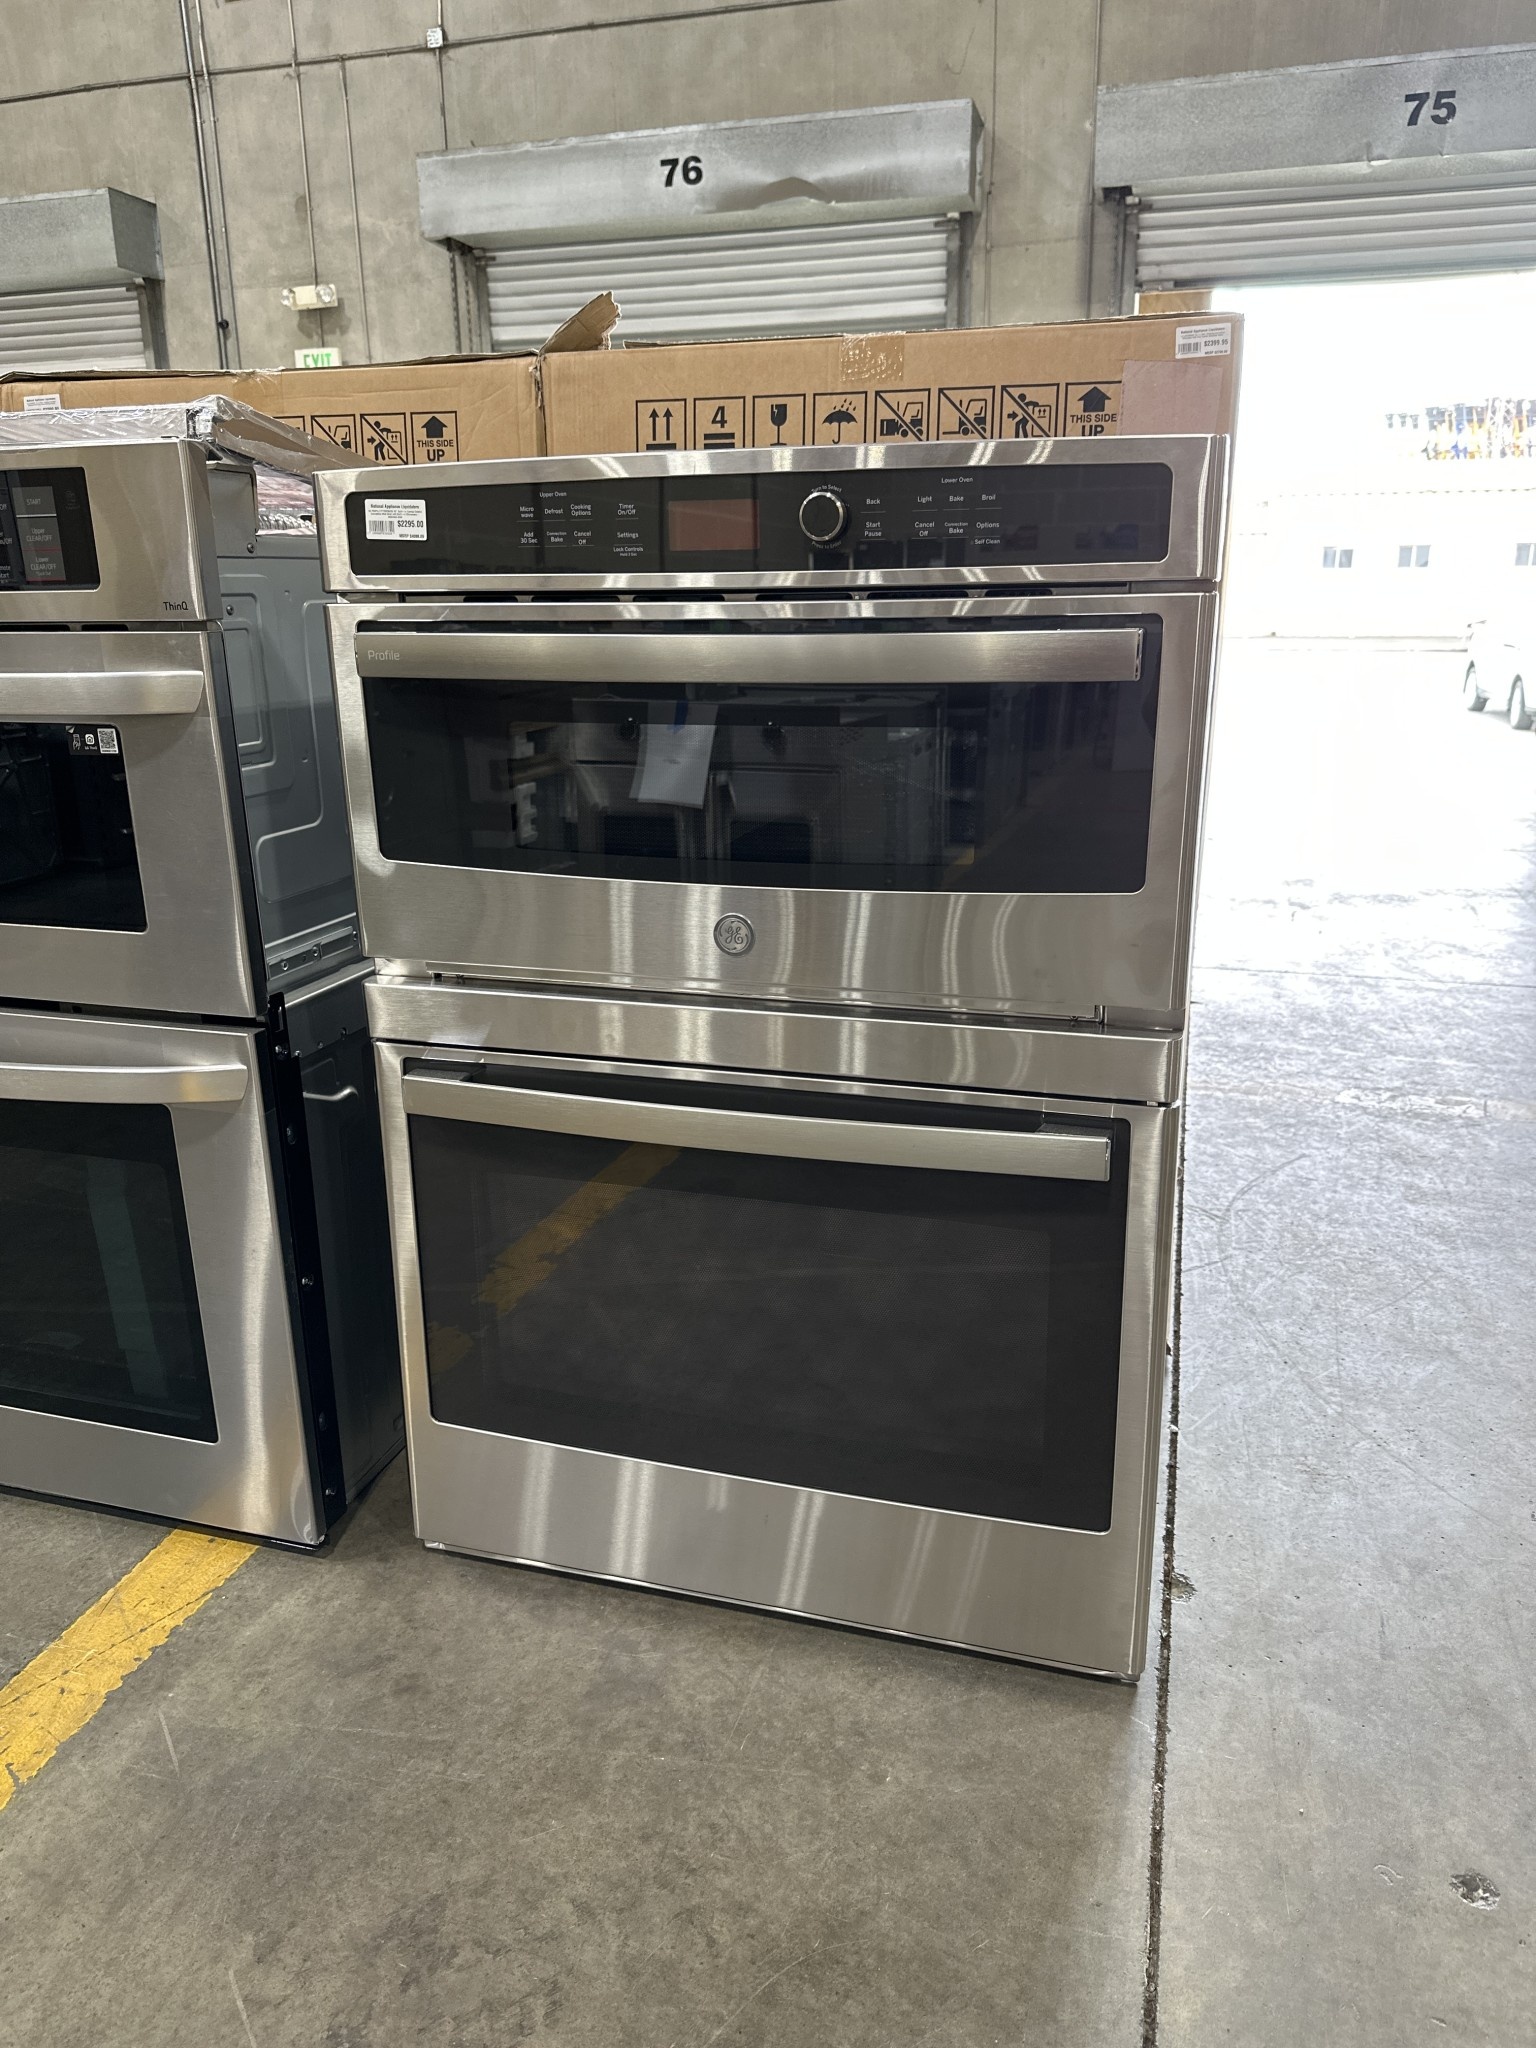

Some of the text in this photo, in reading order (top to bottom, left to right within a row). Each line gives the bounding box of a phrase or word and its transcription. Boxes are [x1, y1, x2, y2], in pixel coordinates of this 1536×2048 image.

[1404, 90, 1456, 126] 75
[660, 155, 703, 187] 76
[711, 405, 728, 428] 4
[1070, 413, 1117, 423] THIS SIDE
[1082, 424, 1105, 436] UP
[417, 439, 454, 448] THIS SIDE
[427, 449, 445, 461] UP
[917, 495, 932, 503] Light
[570, 503, 592, 511] Cooking
[397, 520, 424, 528] $2295.00
[26, 534, 52, 542] CLEAR/OFF
[30, 563, 56, 571] CLEAR/OFF
[163, 601, 188, 611] ThinQ
[367, 649, 400, 661] Profile
